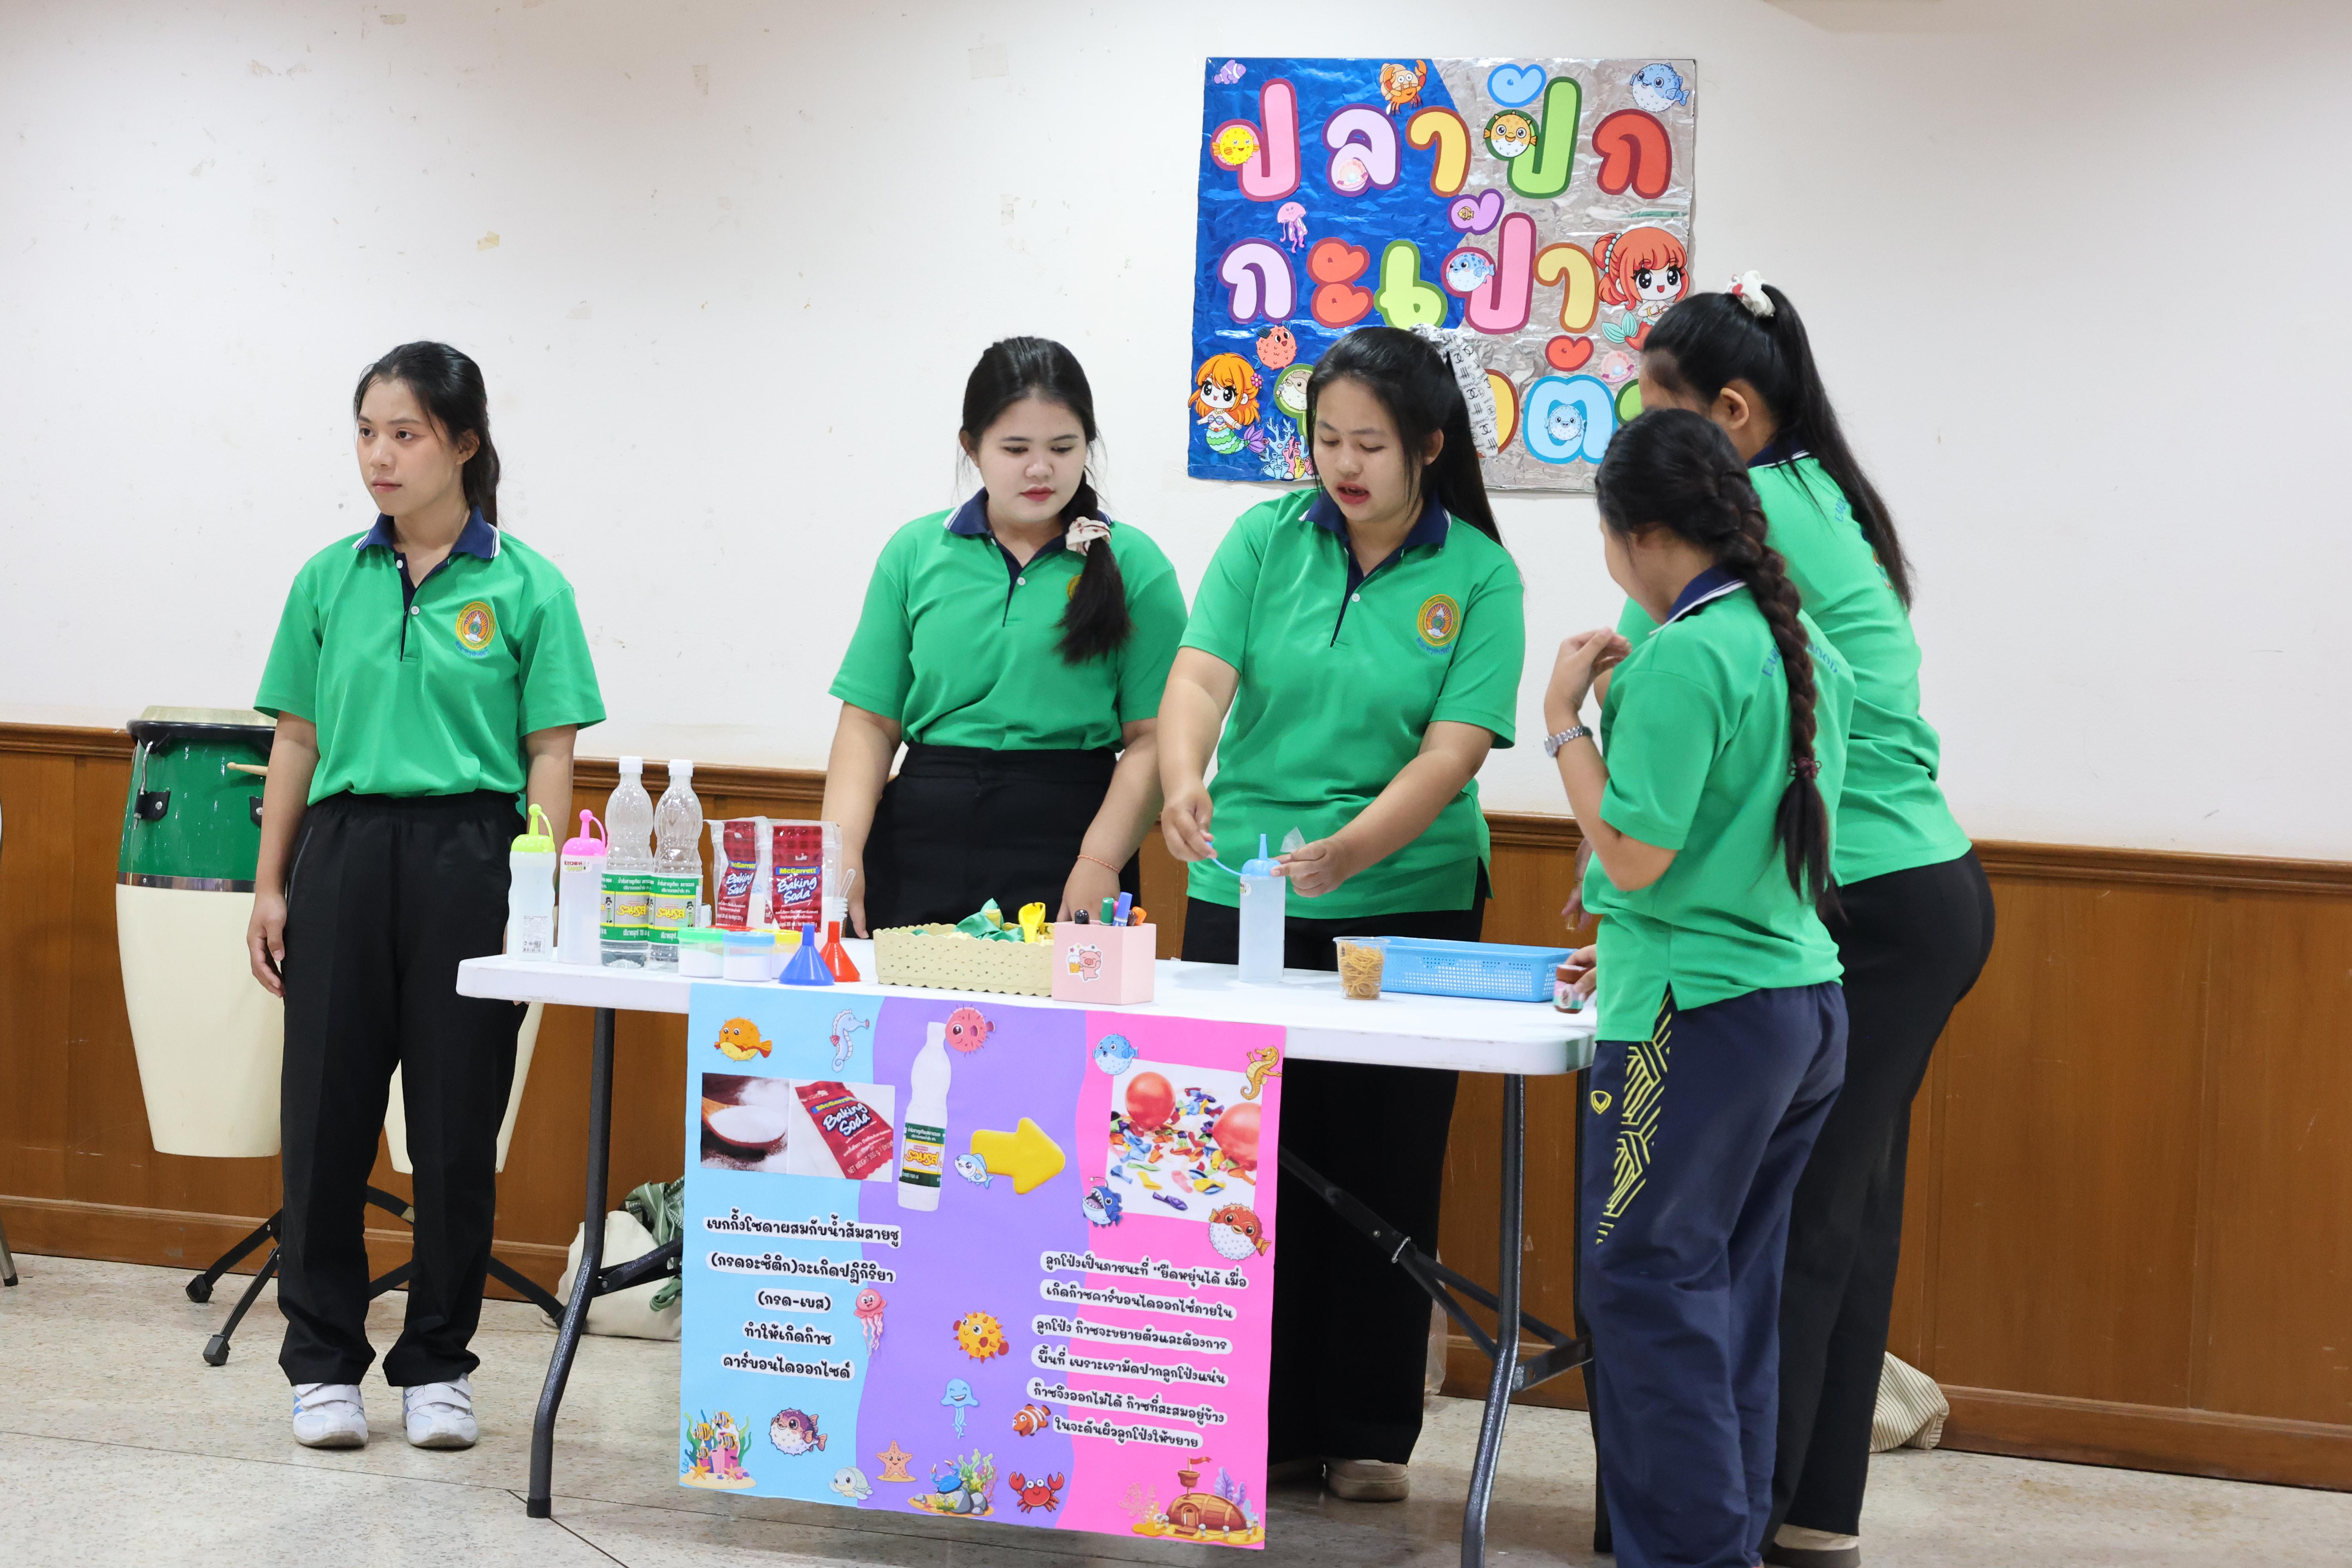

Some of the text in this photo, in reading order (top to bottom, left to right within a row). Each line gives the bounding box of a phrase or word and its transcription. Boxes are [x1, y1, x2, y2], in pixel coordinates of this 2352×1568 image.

[726, 872, 755, 884] Baking
[728, 884, 747, 895] Soda
[777, 877, 817, 893] Baking
[783, 890, 811, 904] Soda
[823, 1103, 868, 1131] Baking
[838, 1113, 871, 1136] Soda
[707, 1208, 899, 1247] เบกกิ้งโซดาผสมกับน้ำส้มสายชู
[1046, 1254, 1149, 1276] ลูกโป่งเป็นภาชนะที่
[1225, 1268, 1247, 1287] เมื่อ
[758, 1291, 831, 1311] (กรด-เบส)
[744, 1321, 832, 1345] ทำให้เกิดก๊าซ
[1037, 1318, 1227, 1350] ลูกโป่ง ก๊าซจะขยายตัวและต้องการ
[724, 1351, 851, 1379] คาร์บอนไดออกไซด์
[1038, 1345, 1066, 1365] พื้นที่
[1034, 1382, 1122, 1408] ก๊าซจึงออกไม่ได้
[1054, 1416, 1198, 1447] ในจะดันผิวลูกโป่งให้ขยาย
